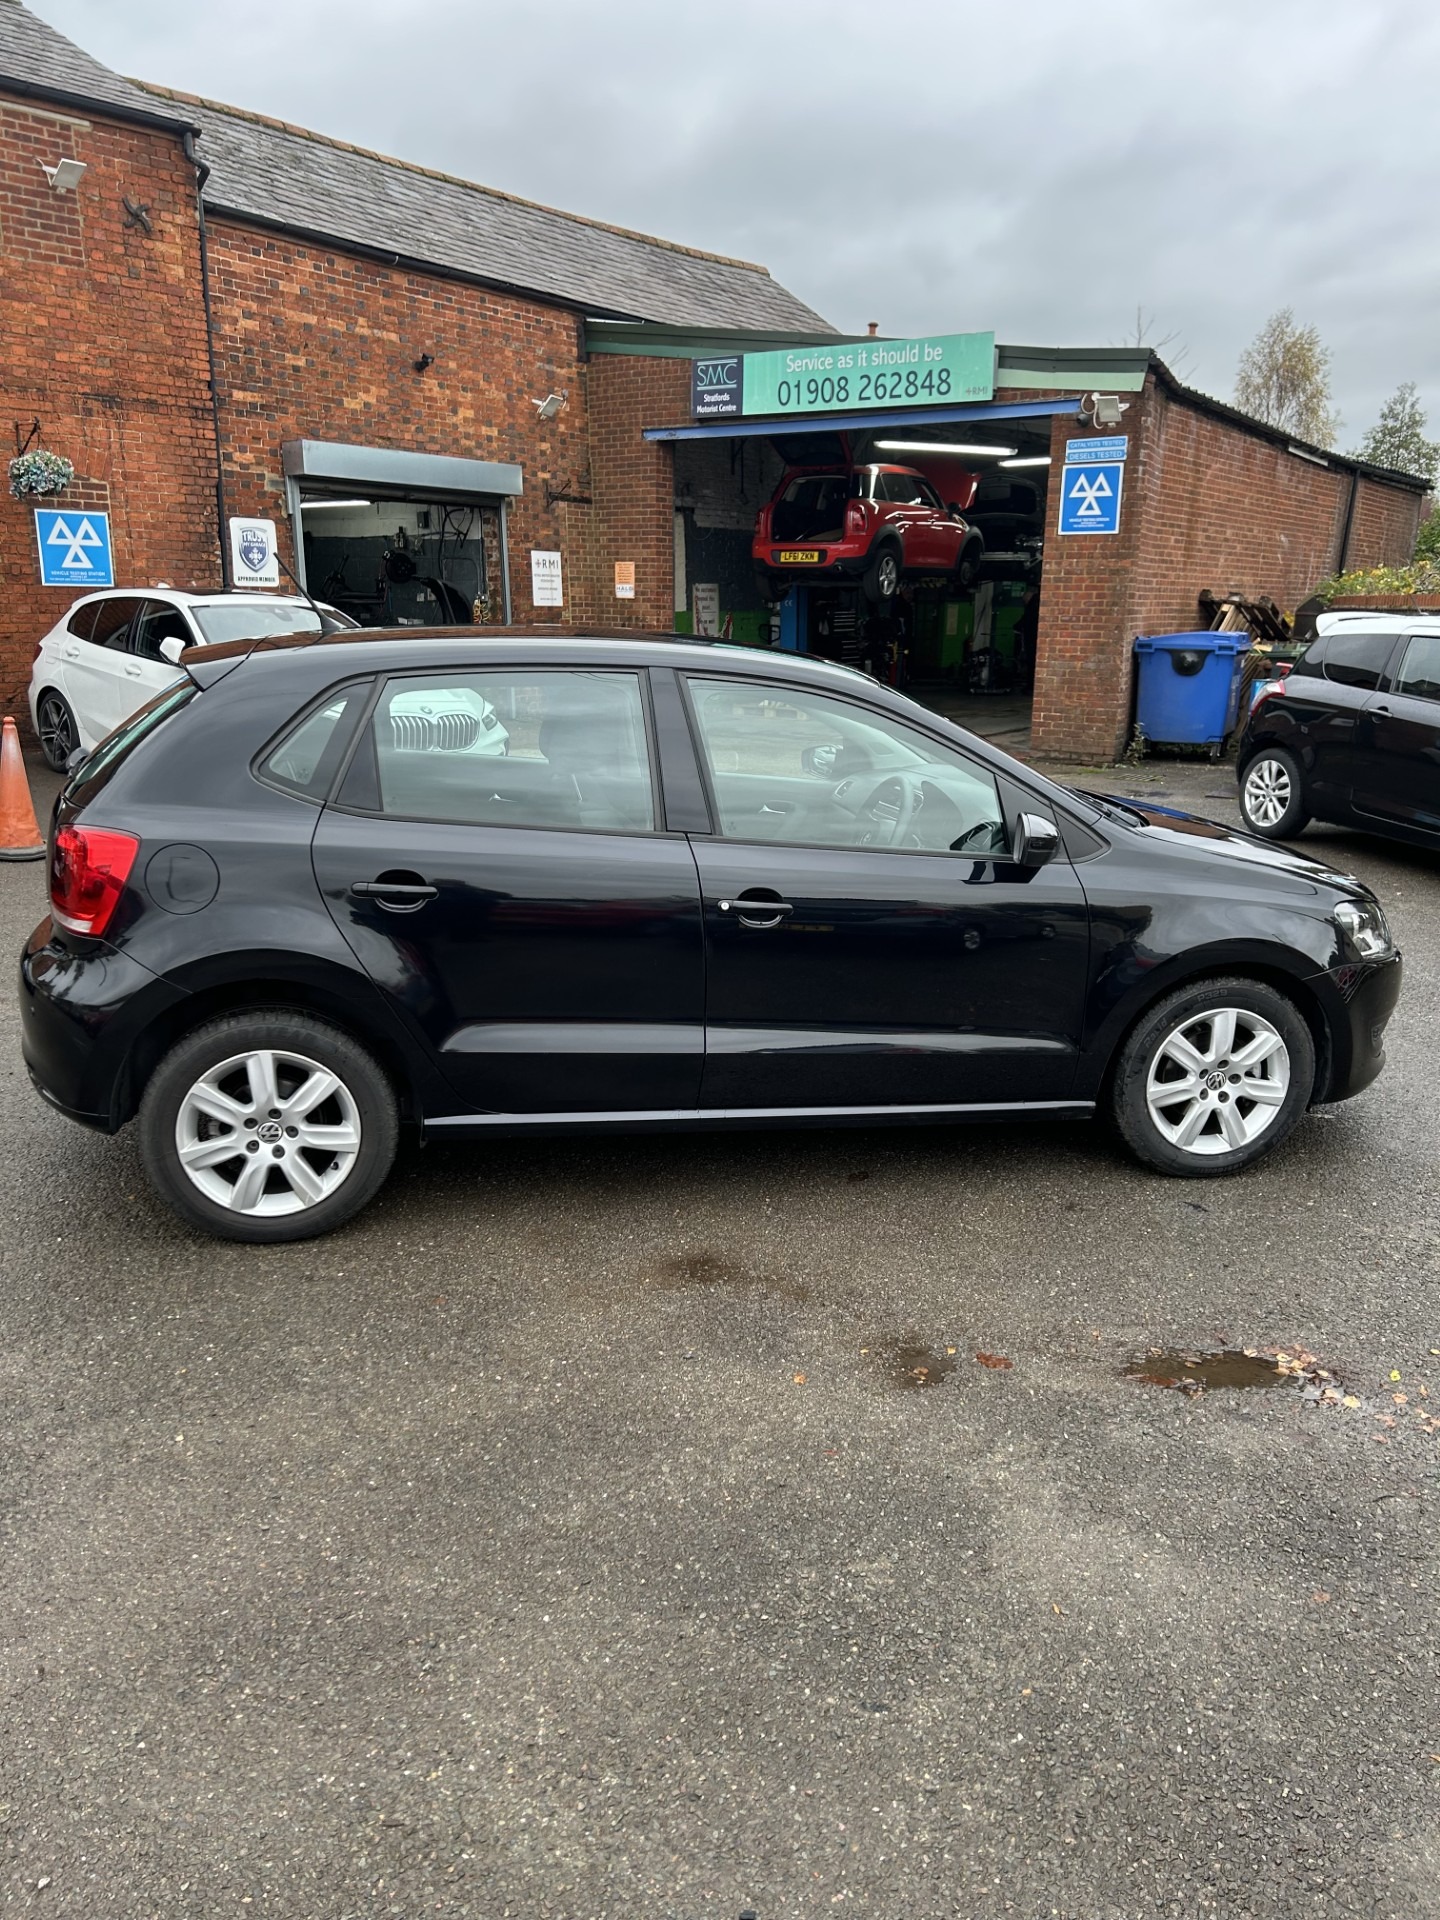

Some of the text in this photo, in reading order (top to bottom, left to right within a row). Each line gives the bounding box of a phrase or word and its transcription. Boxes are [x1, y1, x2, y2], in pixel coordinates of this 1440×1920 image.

[786, 343, 943, 373] Service as it should be
[697, 363, 737, 386] SMC
[777, 368, 951, 406] 01908 262848
[719, 404, 737, 412] Centre
[1070, 451, 1122, 460] DIESELS TESTED
